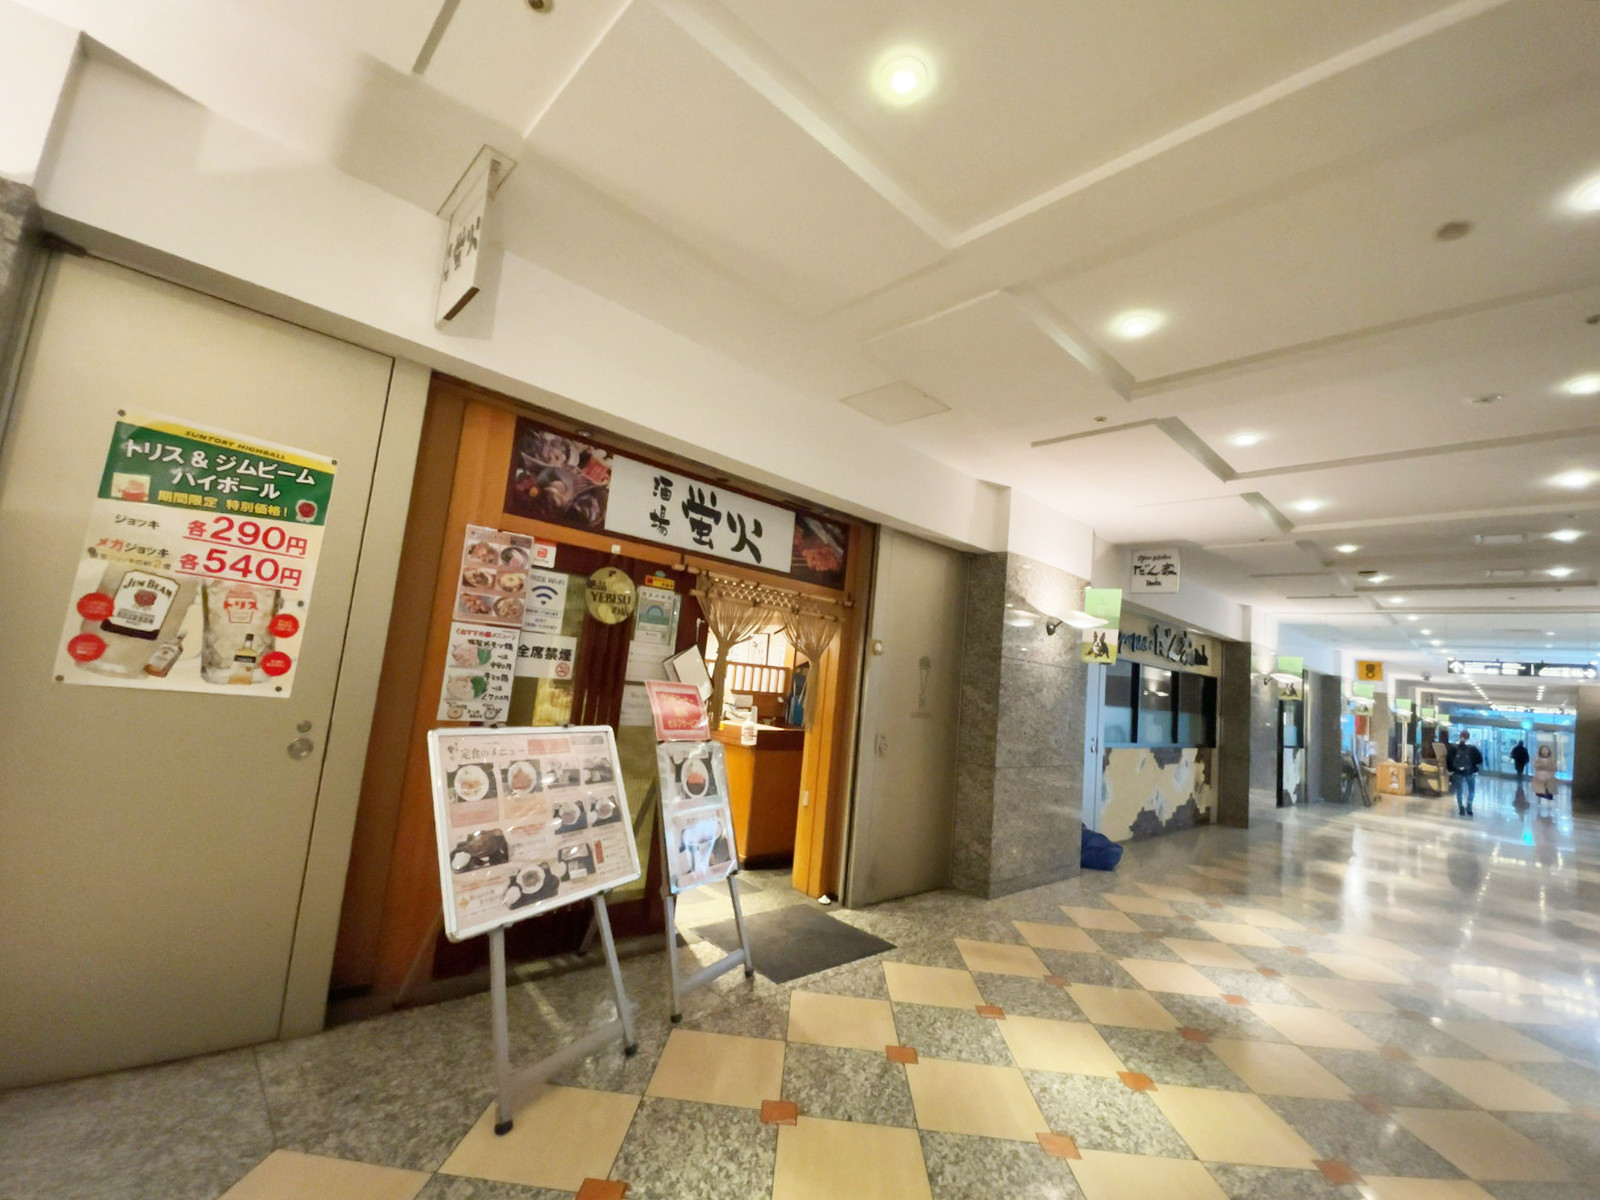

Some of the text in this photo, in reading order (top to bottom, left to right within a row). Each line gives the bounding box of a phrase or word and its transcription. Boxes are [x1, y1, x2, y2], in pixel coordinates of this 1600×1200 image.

[185, 430, 287, 460] SUNTORY HIGHBALL
[126, 438, 315, 485] トリス & ジムビーム
[158, 490, 219, 509] 期間限定
[171, 470, 281, 500] ハイボール
[650, 474, 674, 537] 酒場
[114, 513, 160, 530] ジョッキ
[187, 516, 308, 555] 各290円
[682, 484, 763, 565] 蛍火
[96, 537, 170, 559] メガジョッキ
[179, 548, 302, 586] 各540円
[590, 590, 632, 606] YEBISU
[517, 643, 574, 662] 全席禁煙
